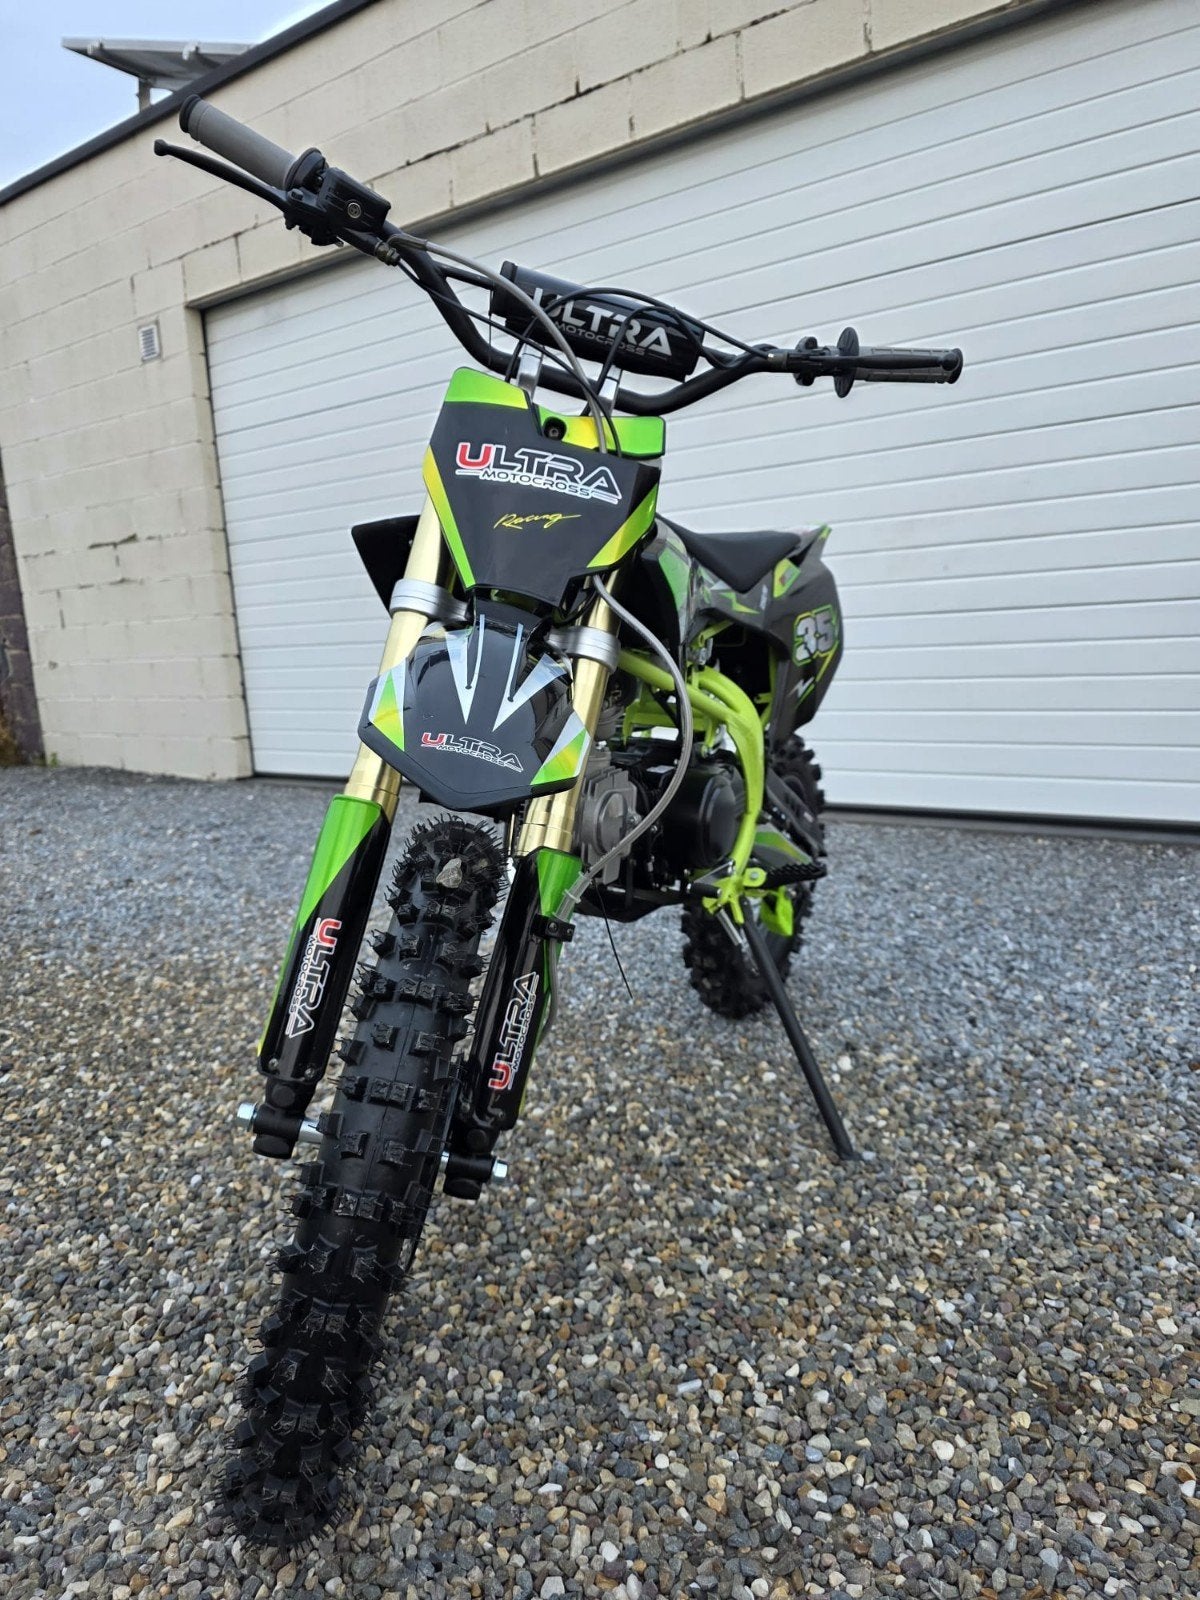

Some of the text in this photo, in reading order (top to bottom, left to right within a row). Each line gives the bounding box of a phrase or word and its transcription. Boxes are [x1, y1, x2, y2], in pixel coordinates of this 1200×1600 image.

[456, 442, 622, 499] ULTRA
[480, 469, 592, 498] MOTOCROSS
[493, 512, 582, 530] Racing
[796, 612, 836, 662] 35
[421, 732, 524, 771] ULTRA
[437, 745, 506, 767] MOTOCROSS
[288, 918, 342, 1039] ULTRA
[289, 934, 318, 1014] MOTOCROSS
[488, 971, 537, 1090] ULTRA
[511, 993, 537, 1072] MOTOCROSS
